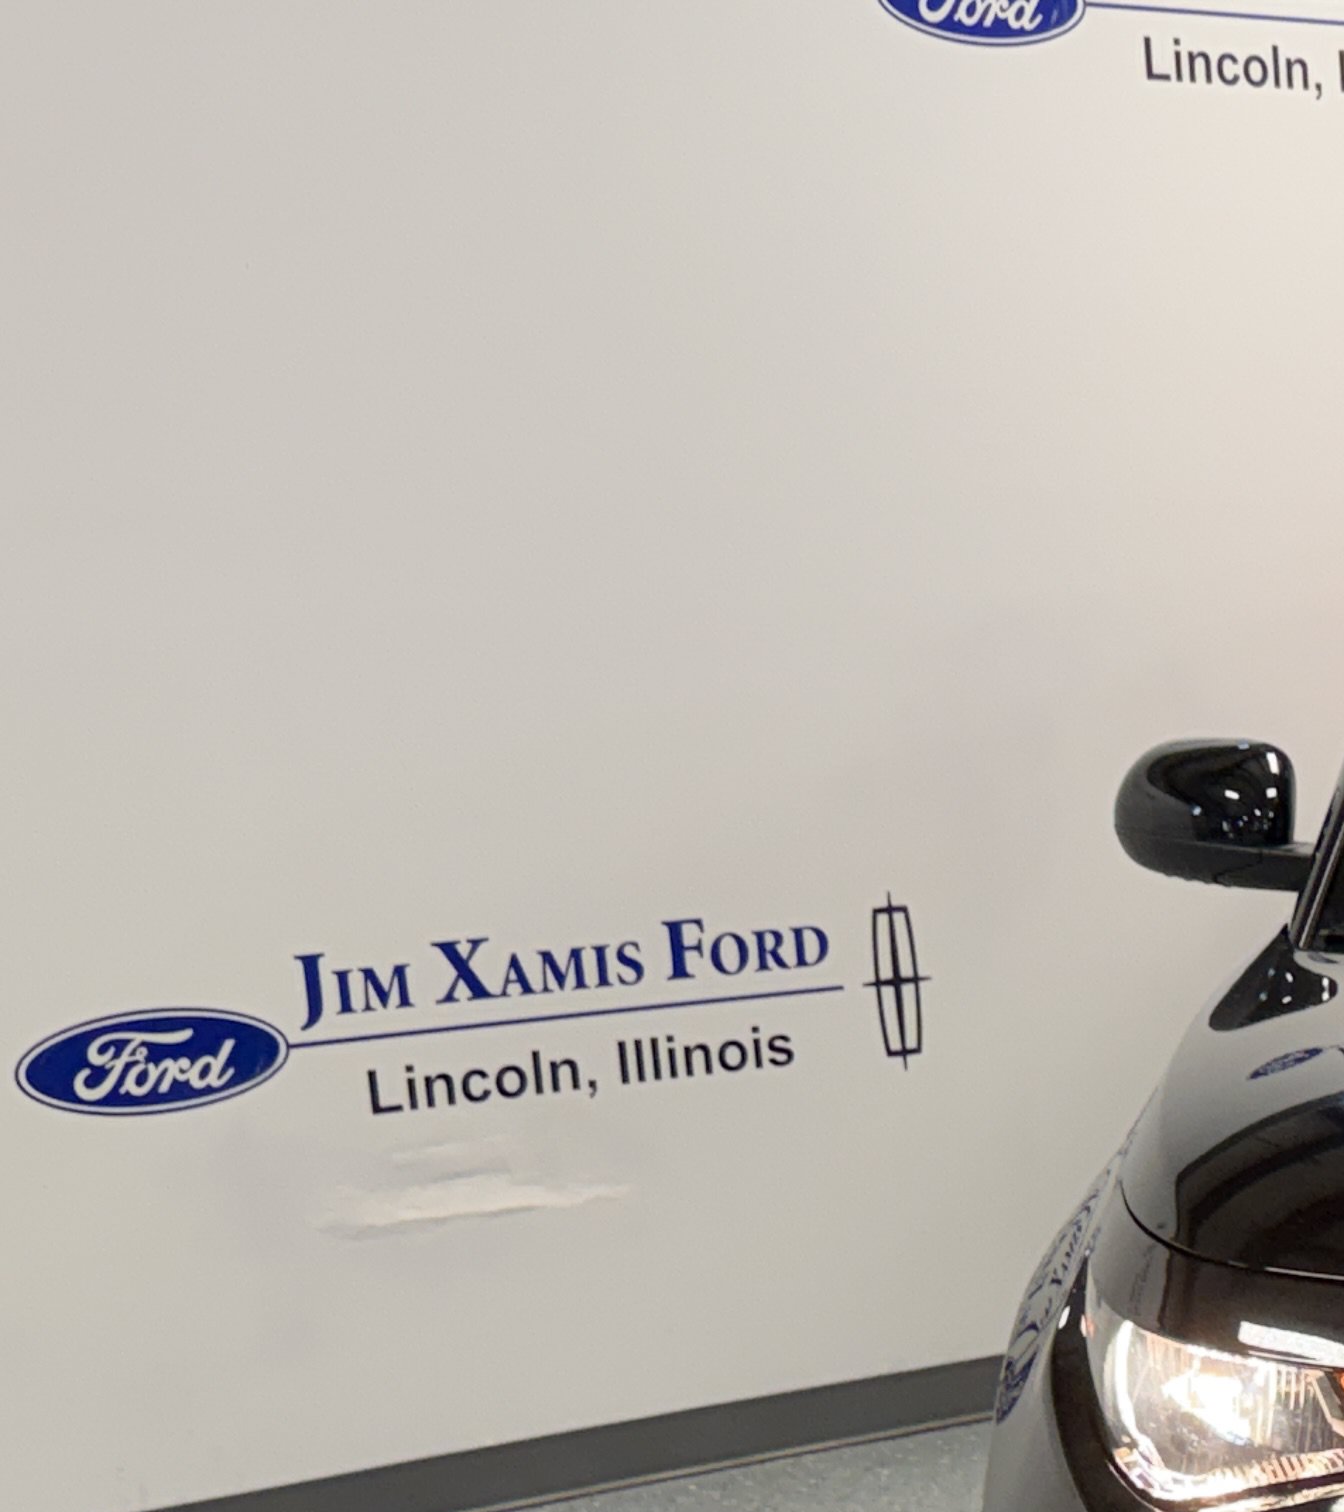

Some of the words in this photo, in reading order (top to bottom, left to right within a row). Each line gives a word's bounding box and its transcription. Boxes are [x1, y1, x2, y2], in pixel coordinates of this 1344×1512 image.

[1142, 36, 1323, 100] Lincoln,
[73, 1027, 236, 1101] Ford
[367, 1050, 598, 1115] Lincoln,
[617, 1026, 795, 1085] Illinois
